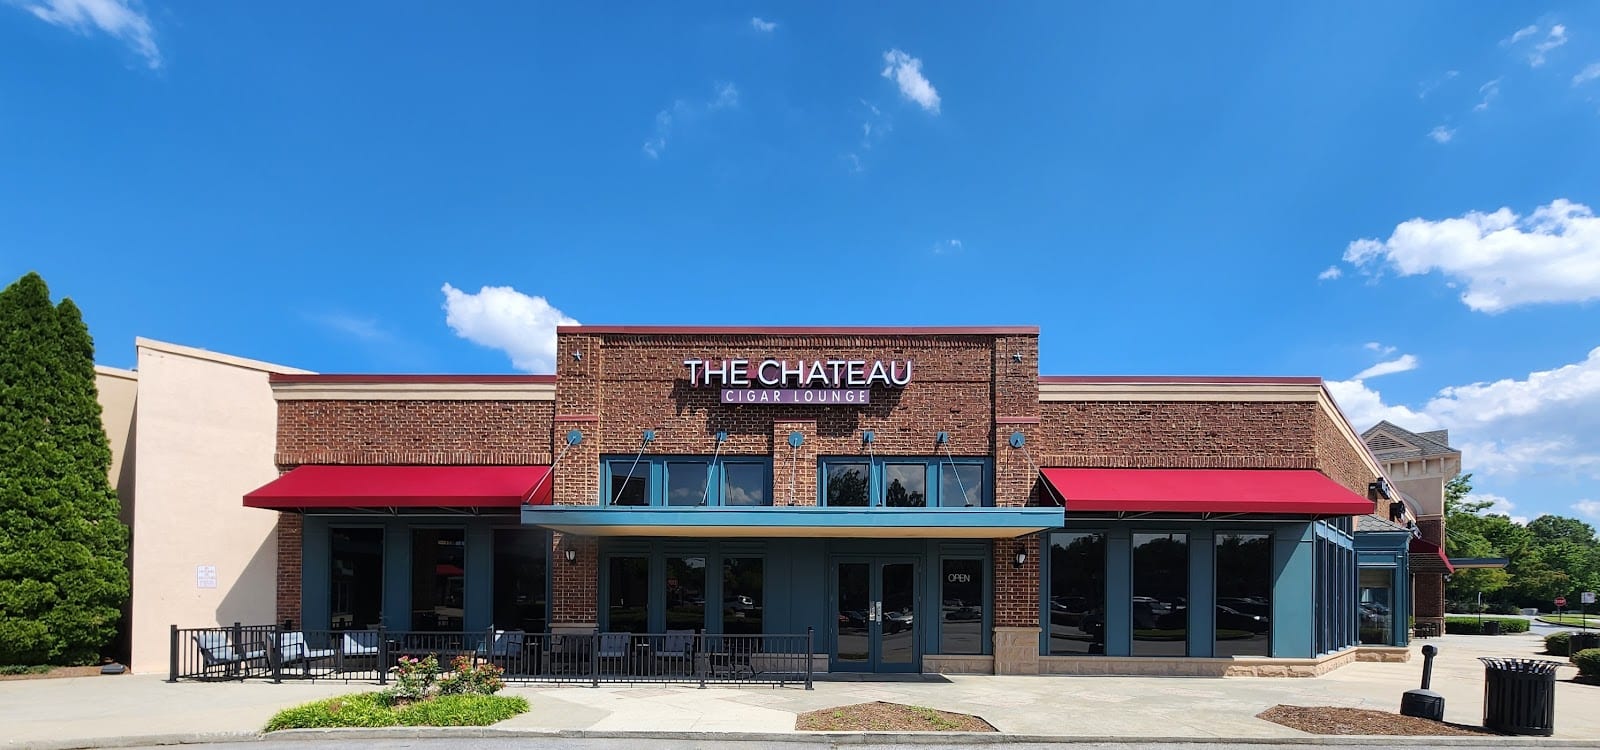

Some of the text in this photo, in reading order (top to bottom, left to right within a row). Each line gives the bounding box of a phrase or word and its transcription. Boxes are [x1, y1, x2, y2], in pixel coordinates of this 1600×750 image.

[684, 360, 912, 385] THE CHATEAU
[725, 390, 866, 402] CIGAR LOUNGE
[947, 573, 970, 583] OPEN
